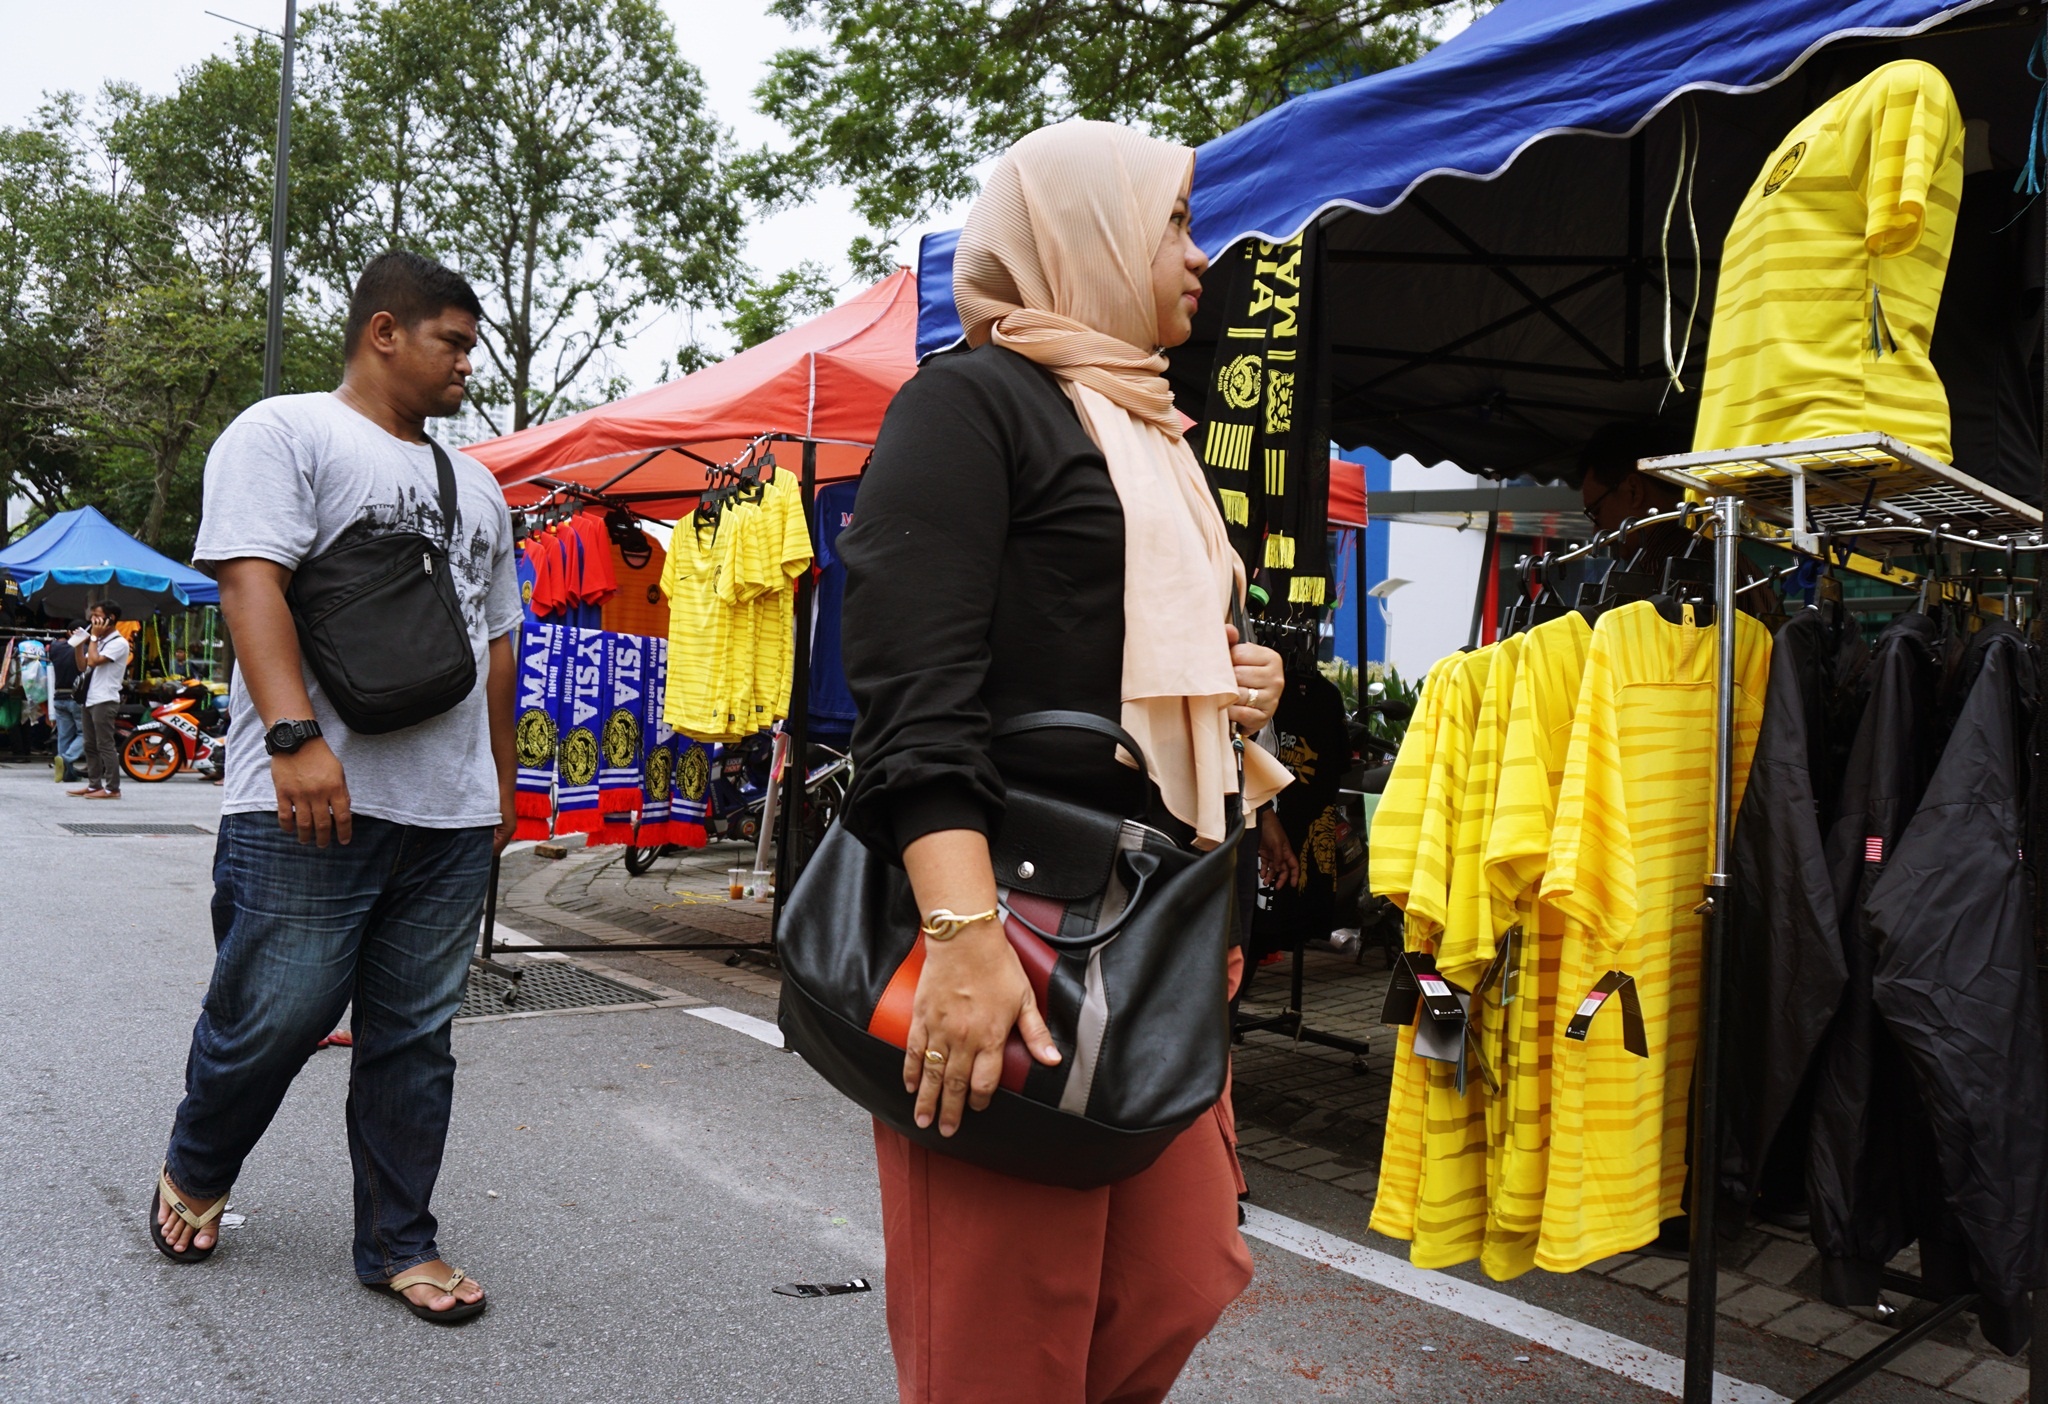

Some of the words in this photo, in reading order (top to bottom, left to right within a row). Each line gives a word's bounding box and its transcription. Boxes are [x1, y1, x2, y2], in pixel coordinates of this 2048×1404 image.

[520, 623, 553, 709] MAL
[547, 665, 559, 698] TANAH
[563, 656, 575, 704] DARAHKU
[647, 678, 656, 724] DARAHKU
